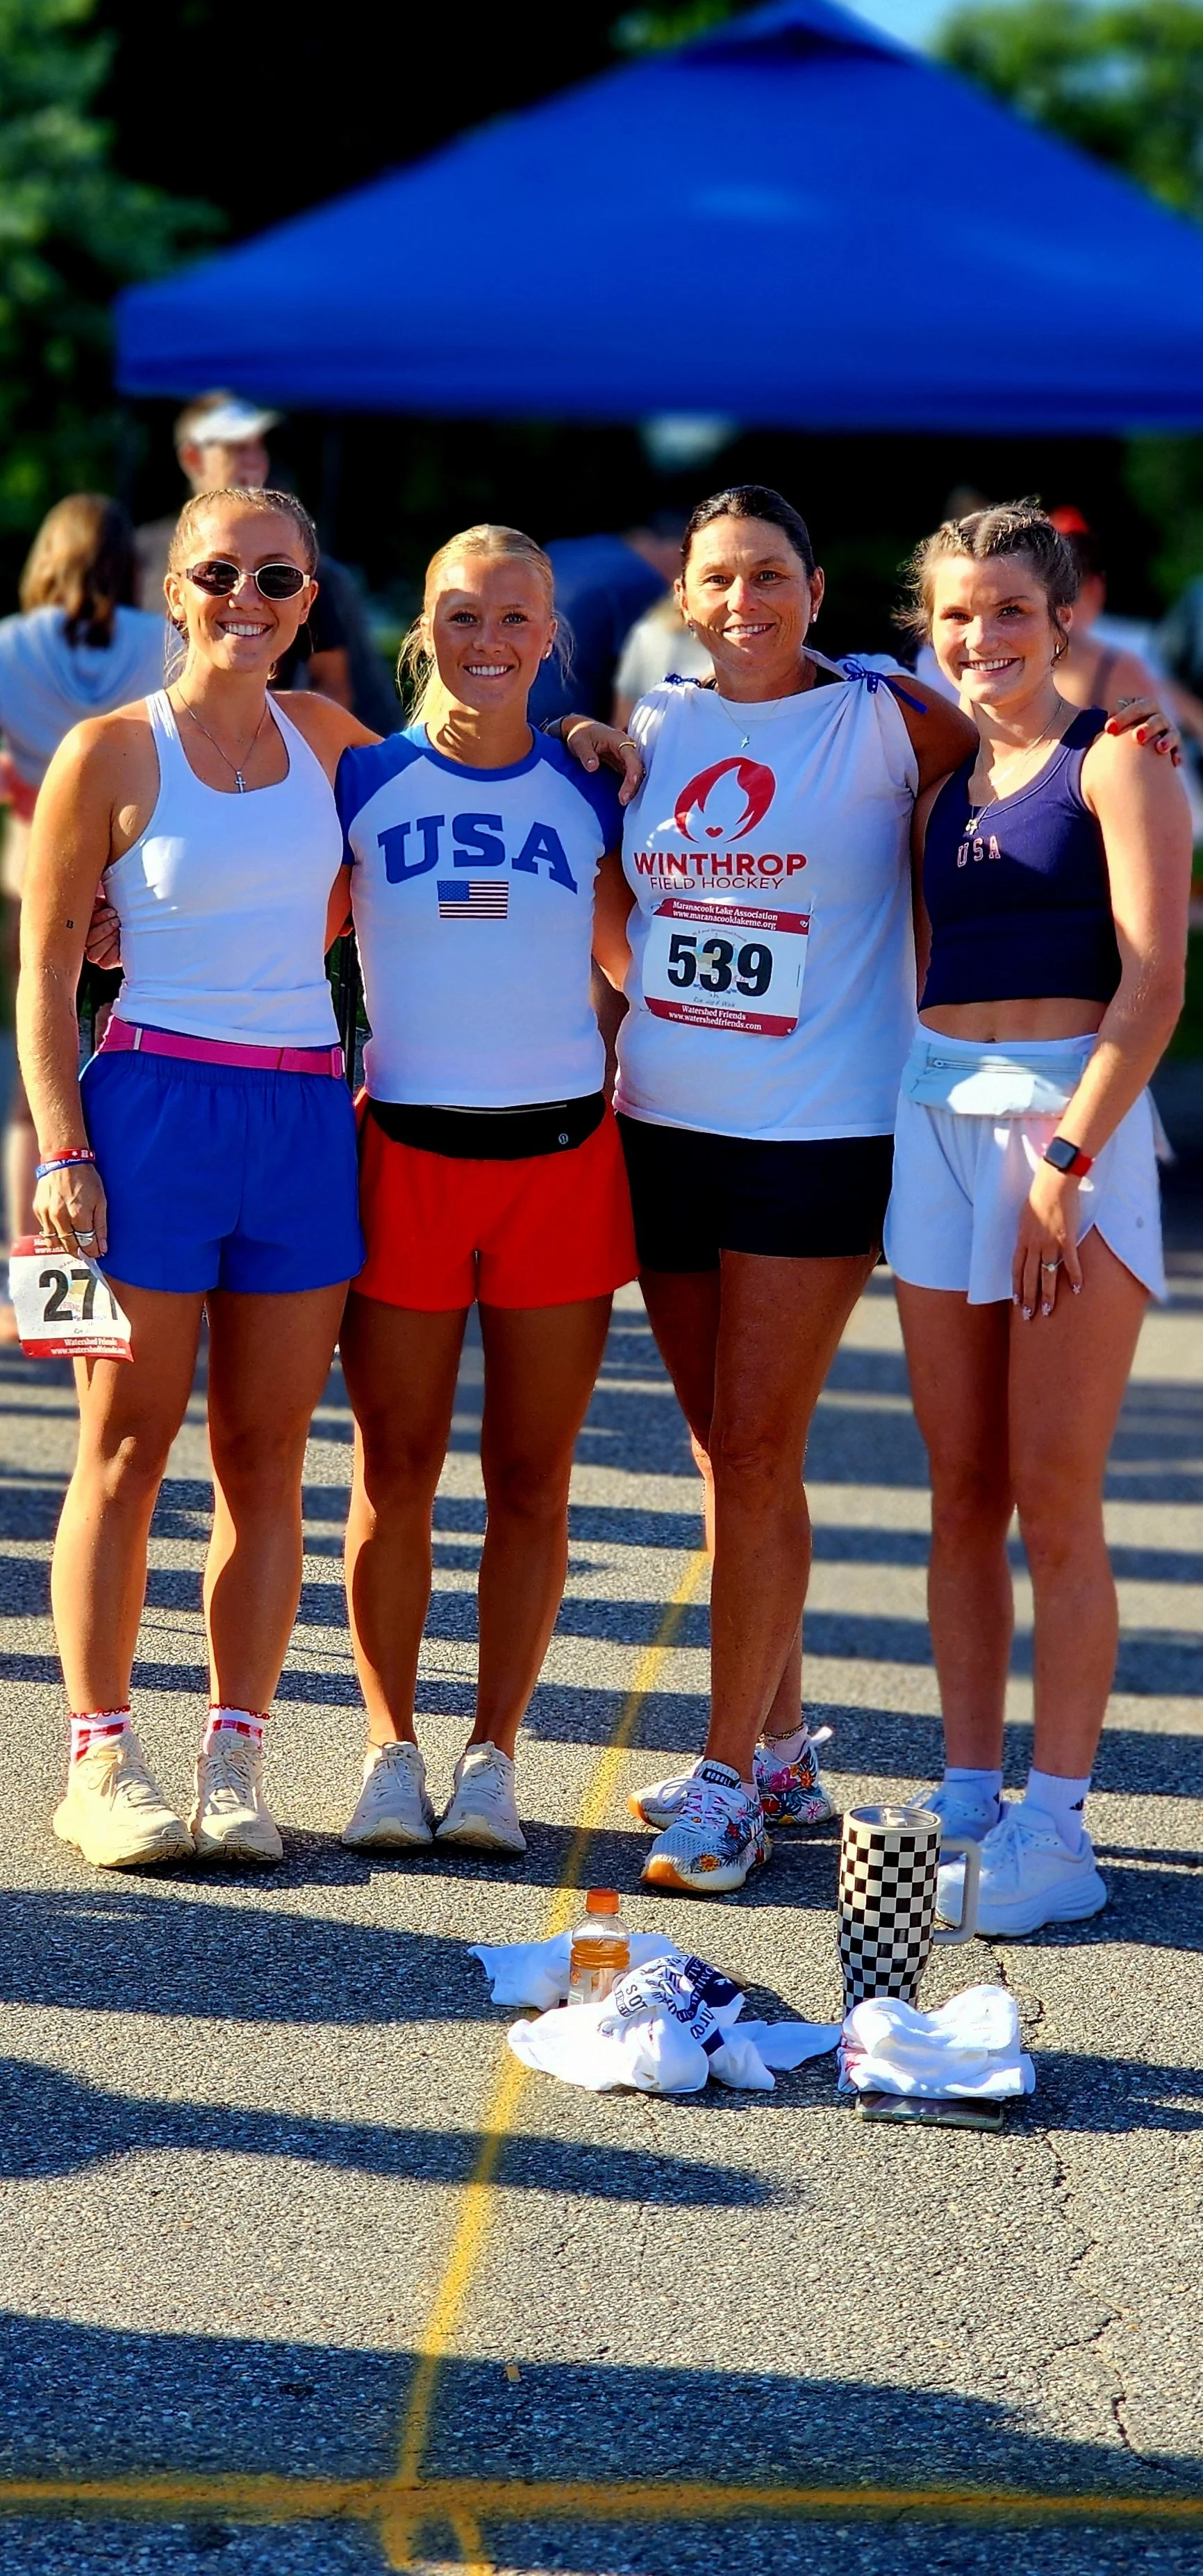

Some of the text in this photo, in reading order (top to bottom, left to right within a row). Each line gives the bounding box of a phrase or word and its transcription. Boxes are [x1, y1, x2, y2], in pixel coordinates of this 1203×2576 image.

[377, 813, 578, 895] USA
[957, 835, 1001, 868] USA
[633, 852, 807, 876] WINTHROP
[650, 877, 785, 890] FIELD HOCKEY
[672, 900, 779, 921] Maranacook Lake Association
[672, 910, 777, 930] www.maranacooklakeme.org
[667, 934, 773, 997] 539
[669, 1012, 763, 1031] www.watershedfriends.com
[682, 1005, 746, 1021] Watershed Friends
